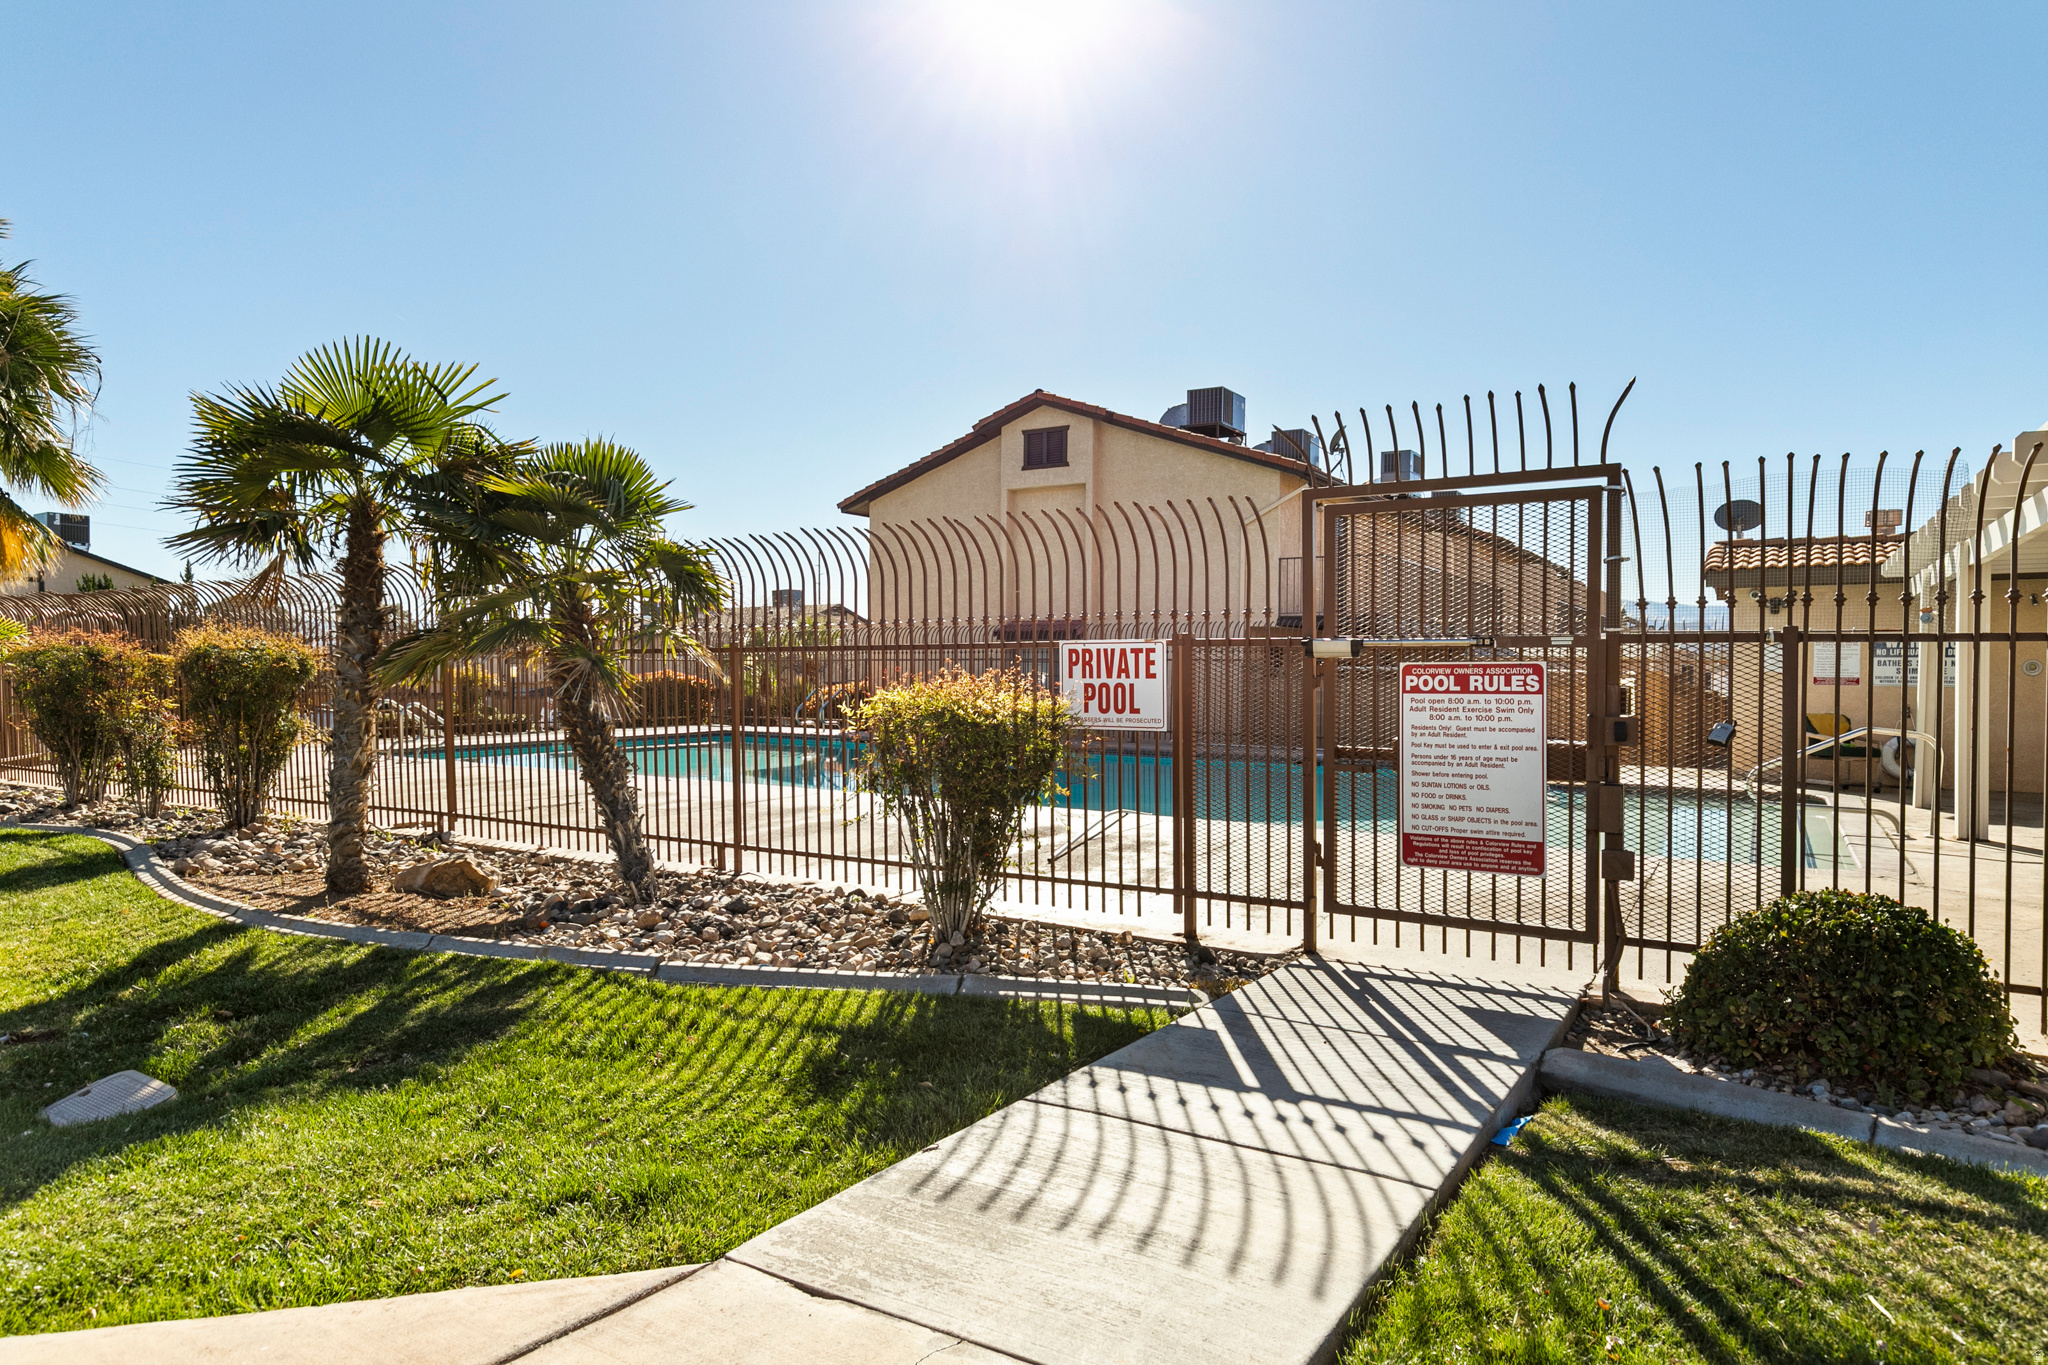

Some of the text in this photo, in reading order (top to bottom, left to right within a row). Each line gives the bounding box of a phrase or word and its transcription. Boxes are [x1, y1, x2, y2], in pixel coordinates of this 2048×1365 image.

[1068, 648, 1157, 679] PRIVATE
[1405, 675, 1540, 692] POOL RULES
[1084, 682, 1140, 714] POOL
[1452, 772, 1473, 780] entering
